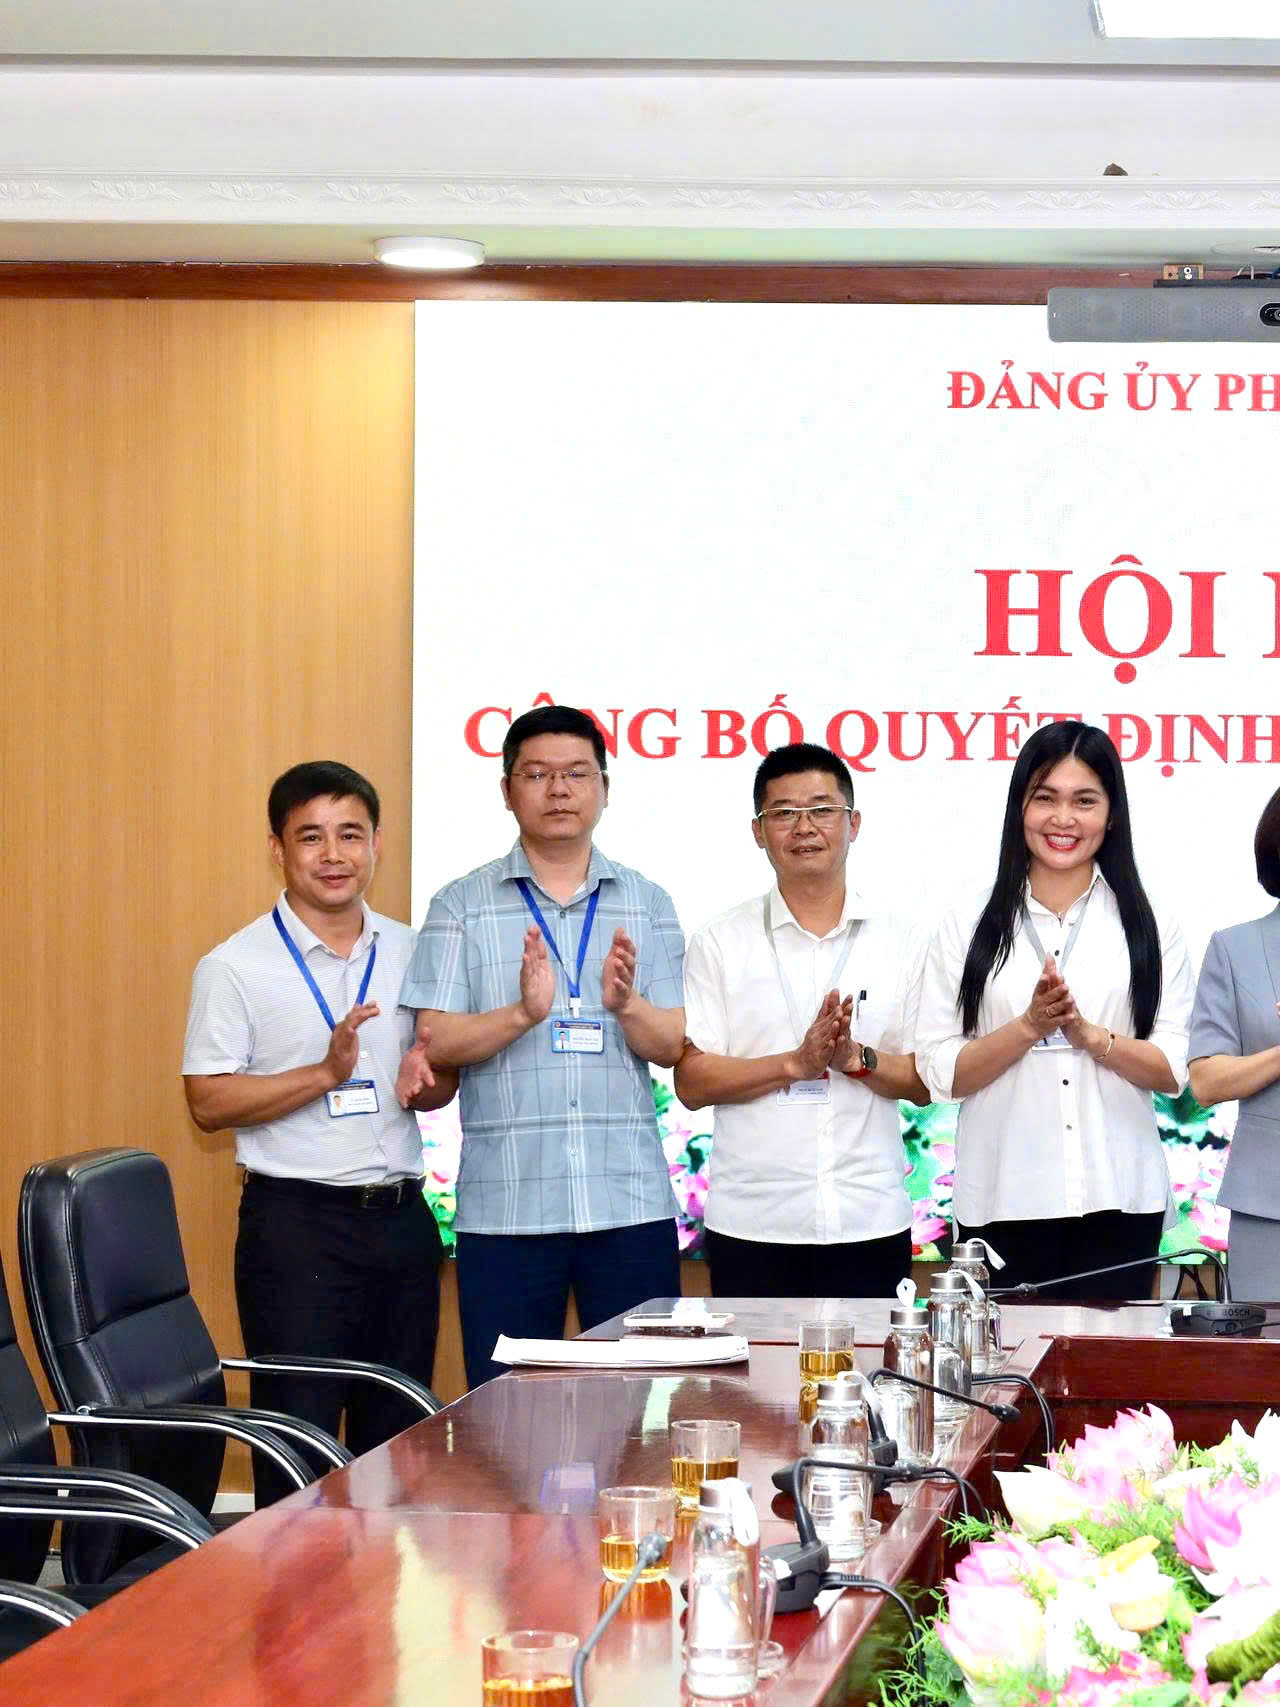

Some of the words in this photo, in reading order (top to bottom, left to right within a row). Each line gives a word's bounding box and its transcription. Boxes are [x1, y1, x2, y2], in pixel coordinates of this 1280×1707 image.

[947, 359, 1107, 411] ĐẢNG
[1125, 361, 1201, 412] ỦY
[974, 554, 1227, 685] HỘI
[463, 692, 682, 760] CNG
[702, 693, 805, 760] BỐ
